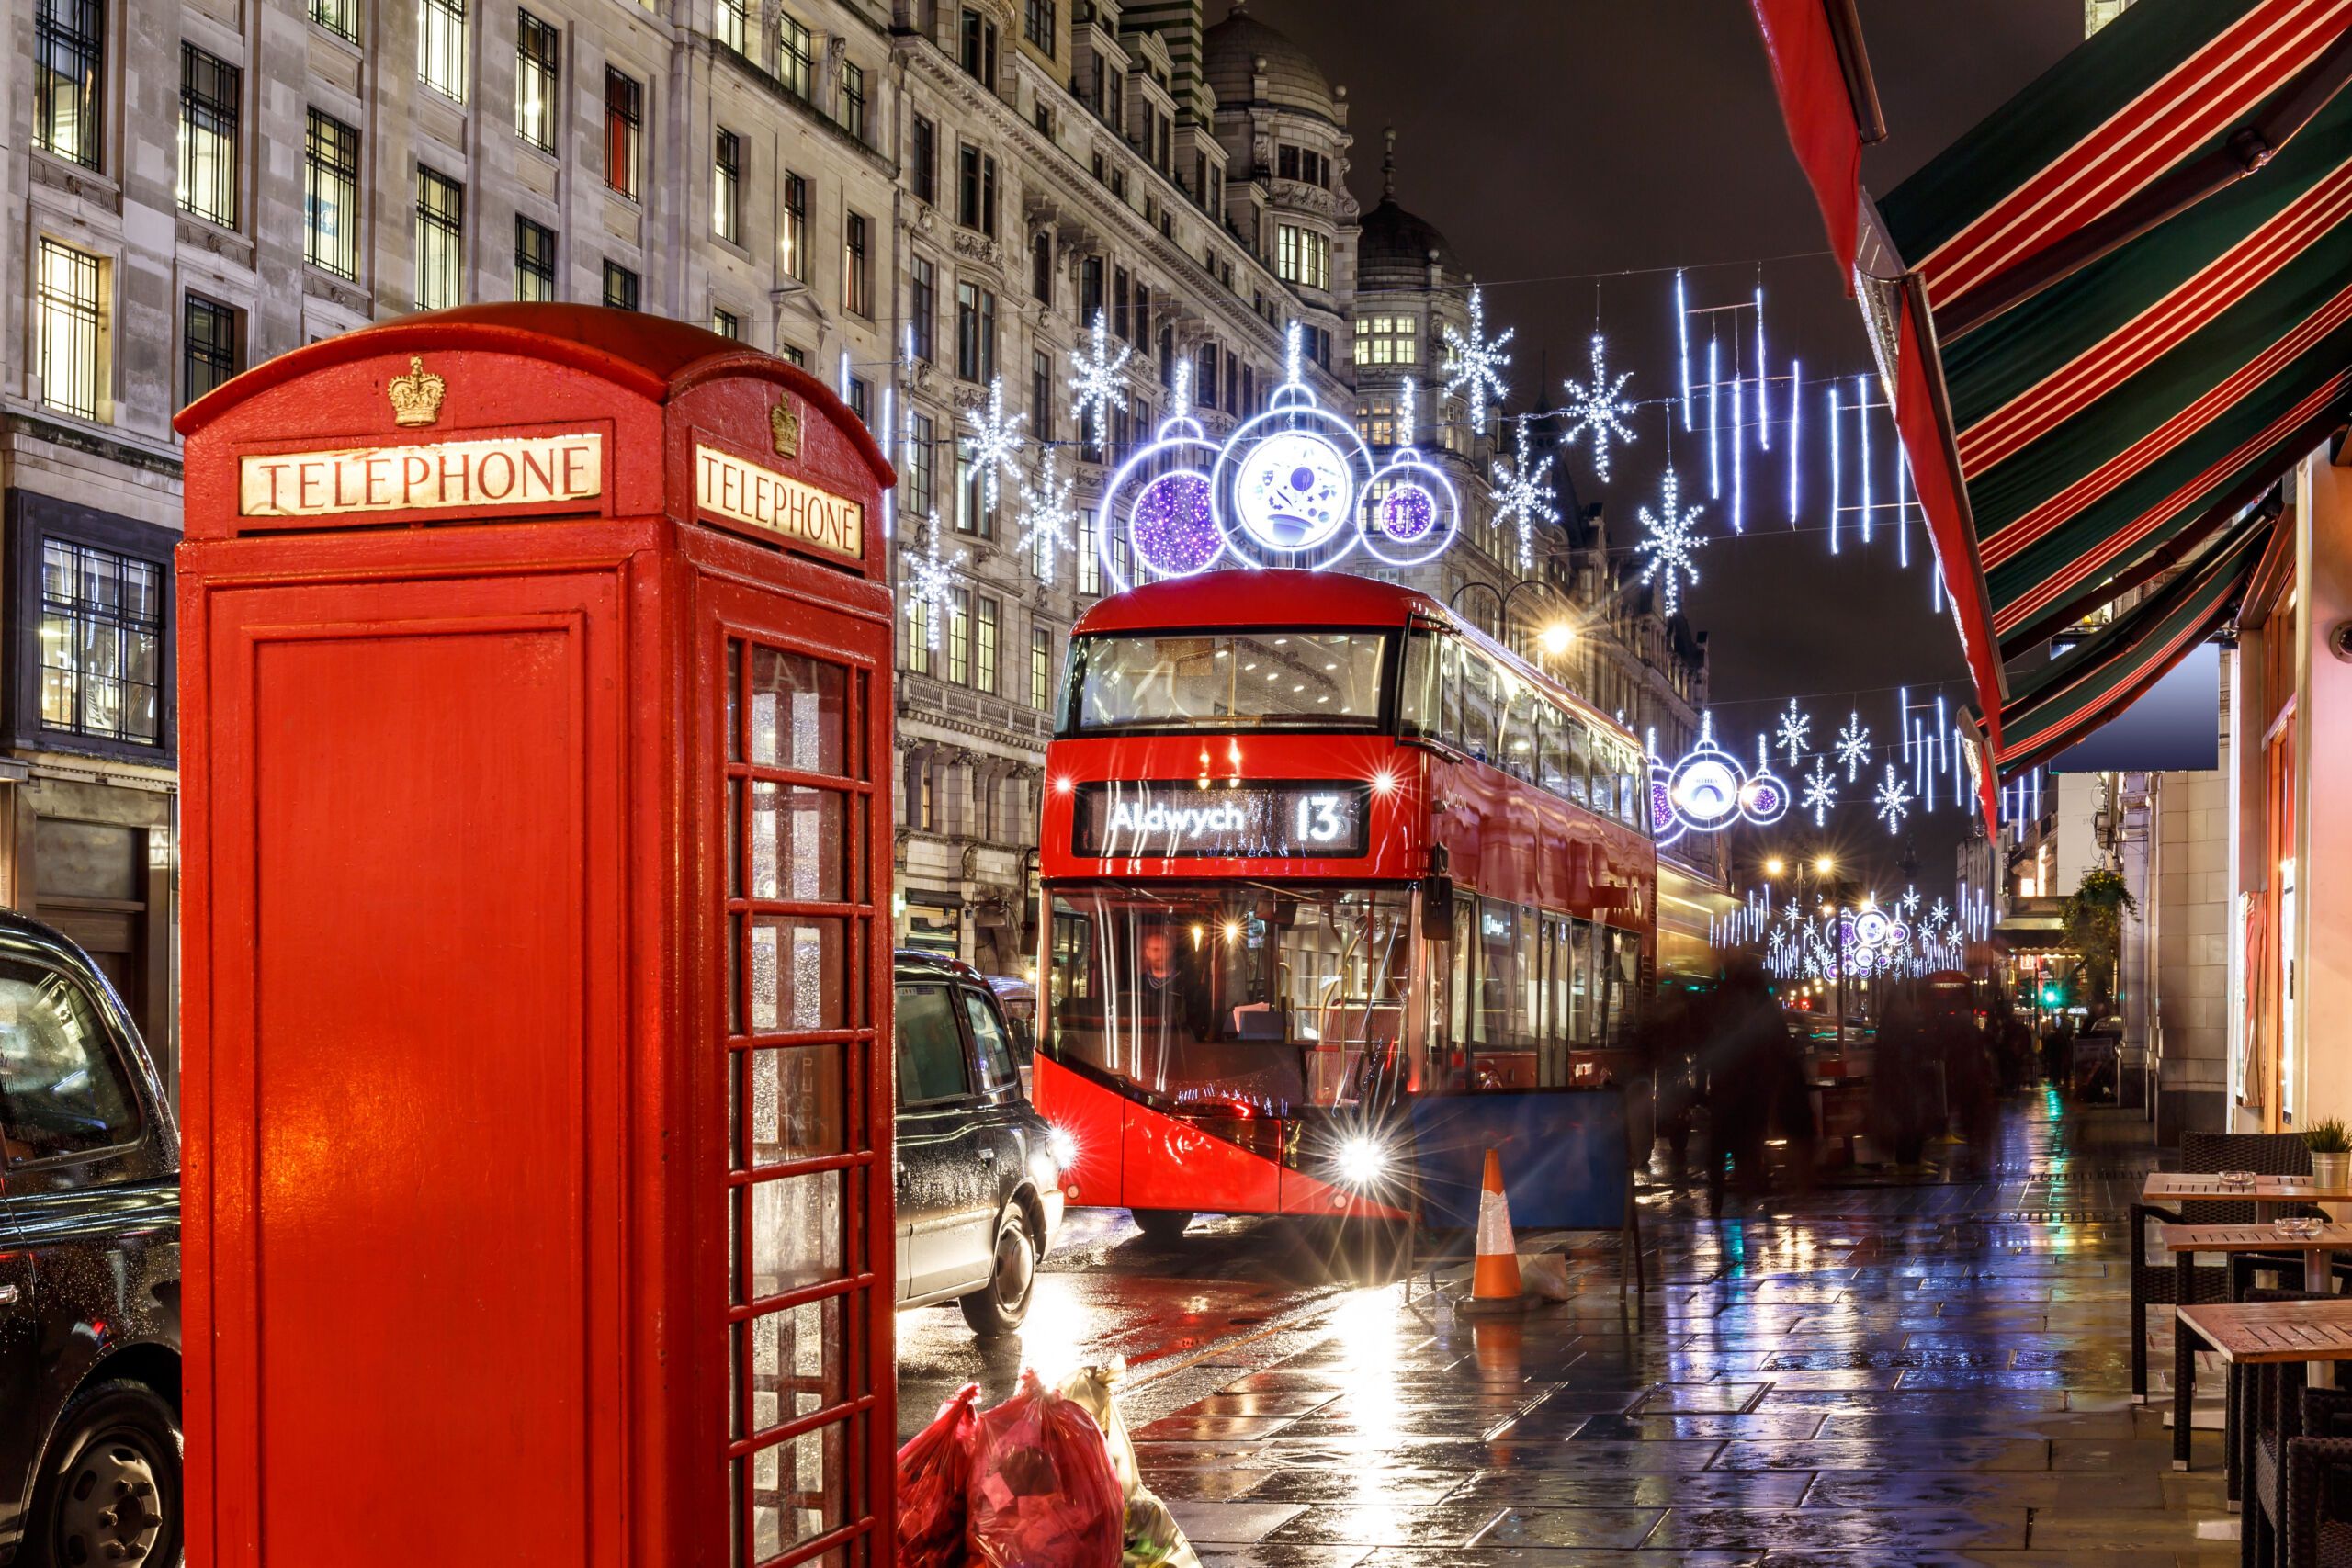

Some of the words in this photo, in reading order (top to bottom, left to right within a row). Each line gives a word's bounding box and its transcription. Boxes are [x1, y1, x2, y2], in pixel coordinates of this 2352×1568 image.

[259, 446, 590, 510] TELEPHONE
[702, 455, 854, 551] TELEPHONE
[1110, 800, 1244, 838] Aldwych
[1298, 796, 1339, 841] 13
